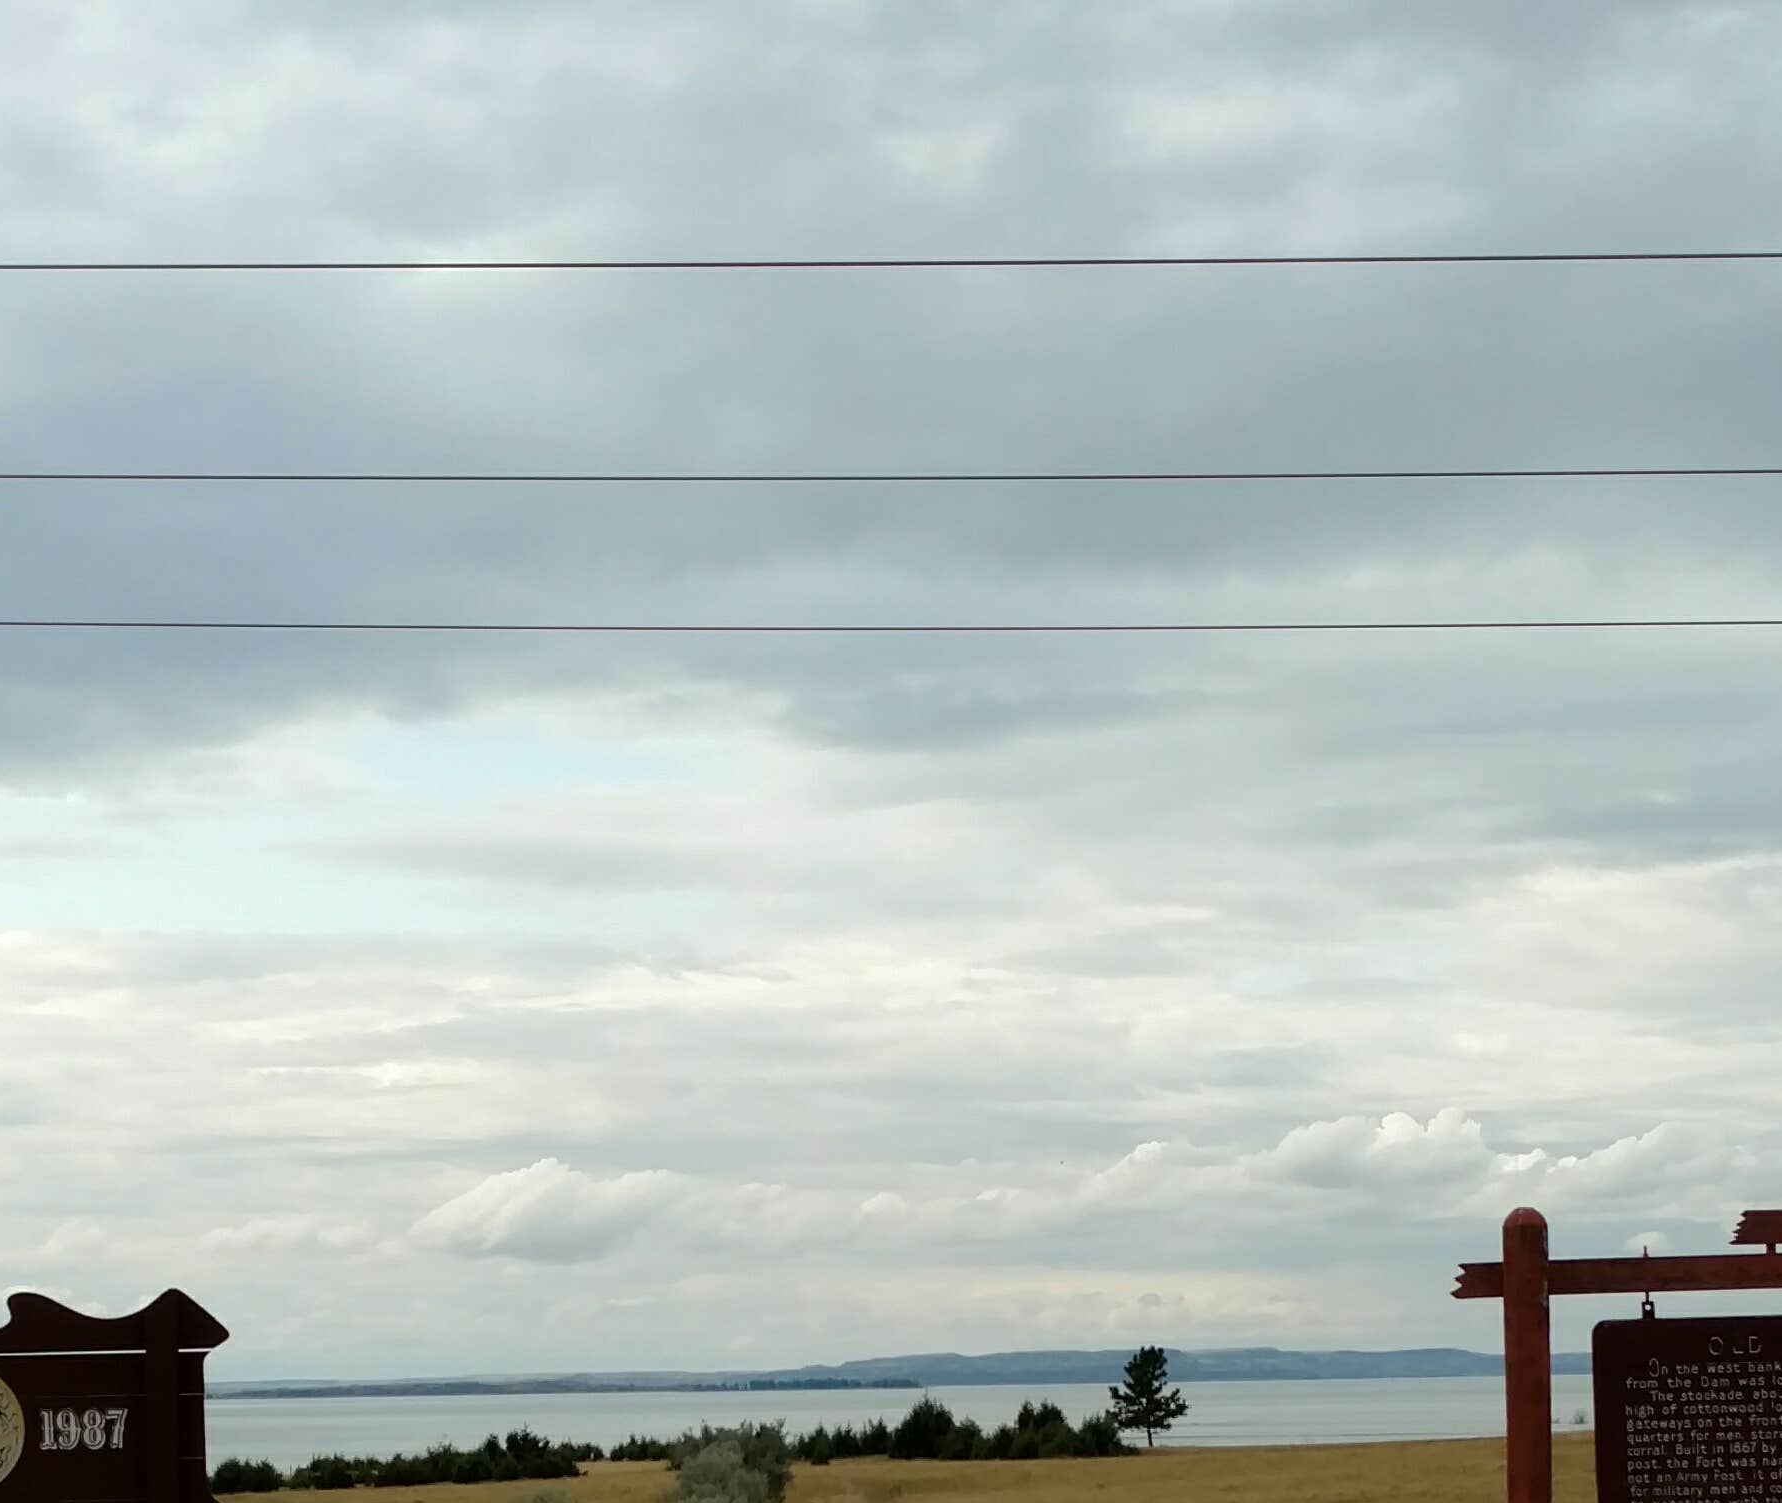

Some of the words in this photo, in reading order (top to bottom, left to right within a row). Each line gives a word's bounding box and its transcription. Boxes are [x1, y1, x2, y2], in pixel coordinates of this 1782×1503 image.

[1708, 1336, 1762, 1356] OLD
[1676, 1363, 1699, 1374] the
[1707, 1362, 1741, 1373] west
[1748, 1361, 1782, 1372] bank
[1626, 1377, 1658, 1389] from
[1667, 1377, 1691, 1388] the
[1701, 1376, 1730, 1388] Dam
[1738, 1377, 1765, 1386] was
[1651, 1390, 1673, 1401] The
[1680, 1389, 1743, 1401] stockade
[1626, 1405, 1654, 1418] high
[1662, 1403, 1676, 1414] of
[1683, 1402, 1763, 1414] cottonwood
[39, 1408, 129, 1451] 1987
[1627, 1417, 1691, 1431] gateways
[1697, 1418, 1713, 1428] on
[1719, 1416, 1742, 1427] the
[1627, 1430, 1684, 1444] quarters
[1691, 1430, 1709, 1441] for
[1675, 1443, 1707, 1455] Built
[1730, 1442, 1757, 1453] 1867
[1762, 1441, 1776, 1454] by
[1667, 1457, 1689, 1468] the
[1696, 1456, 1724, 1467] Fort
[1731, 1458, 1756, 1467] was
[1656, 1472, 1672, 1481] an
[1676, 1470, 1708, 1483] Army
[1630, 1486, 1647, 1496] for
[1653, 1485, 1703, 1497] military
[1710, 1485, 1736, 1495] men
[1741, 1483, 1763, 1494] and
